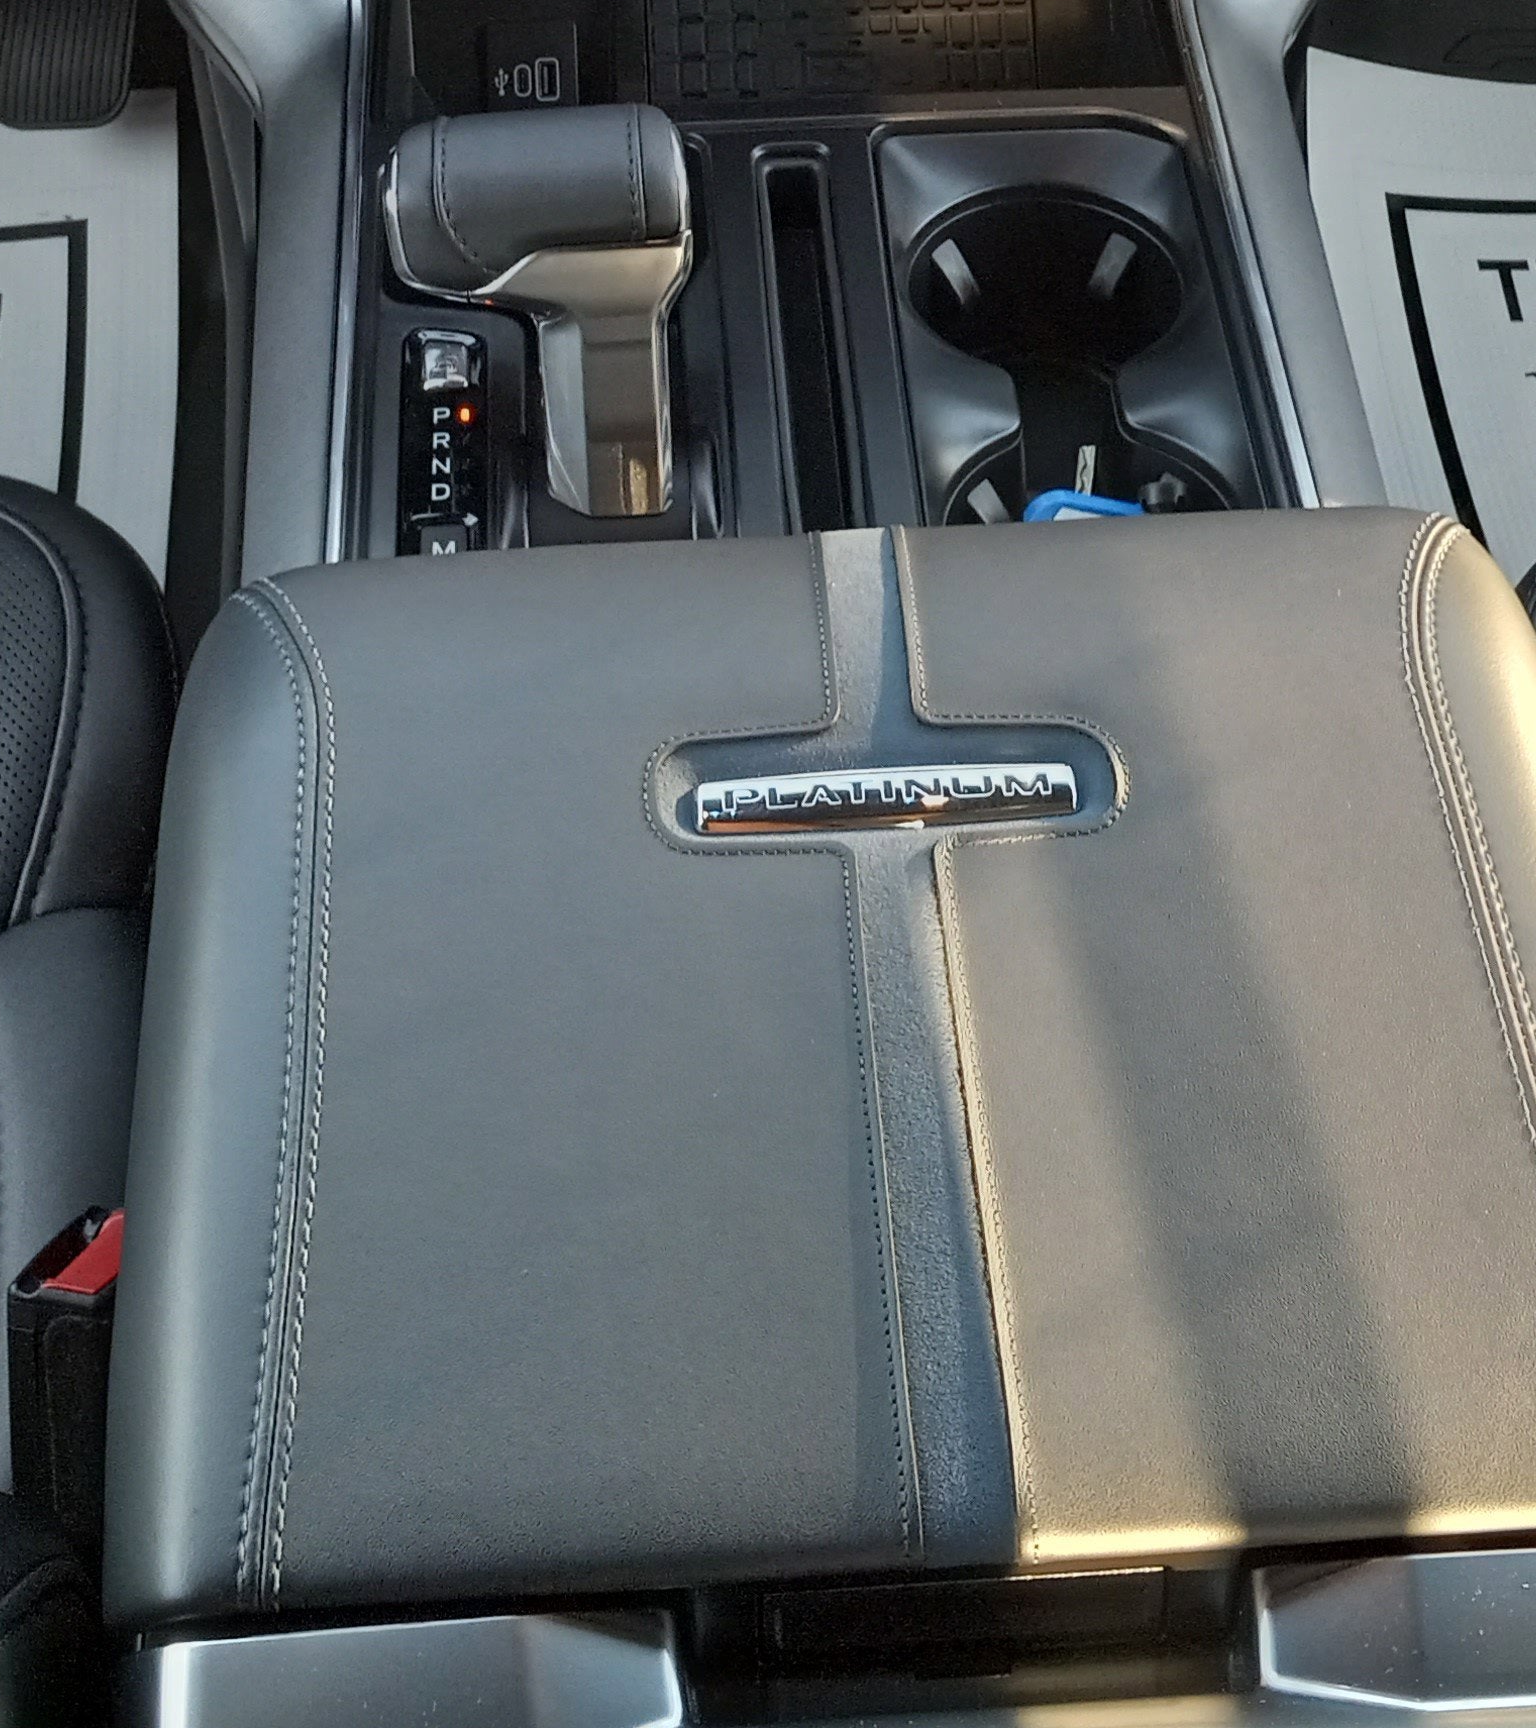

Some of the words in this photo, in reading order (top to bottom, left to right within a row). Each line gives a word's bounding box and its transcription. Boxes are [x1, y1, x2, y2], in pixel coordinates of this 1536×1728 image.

[433, 406, 451, 424] P
[432, 431, 451, 449] R
[431, 456, 451, 475] N
[431, 483, 451, 502] D
[723, 772, 1053, 815] PLATINUM
